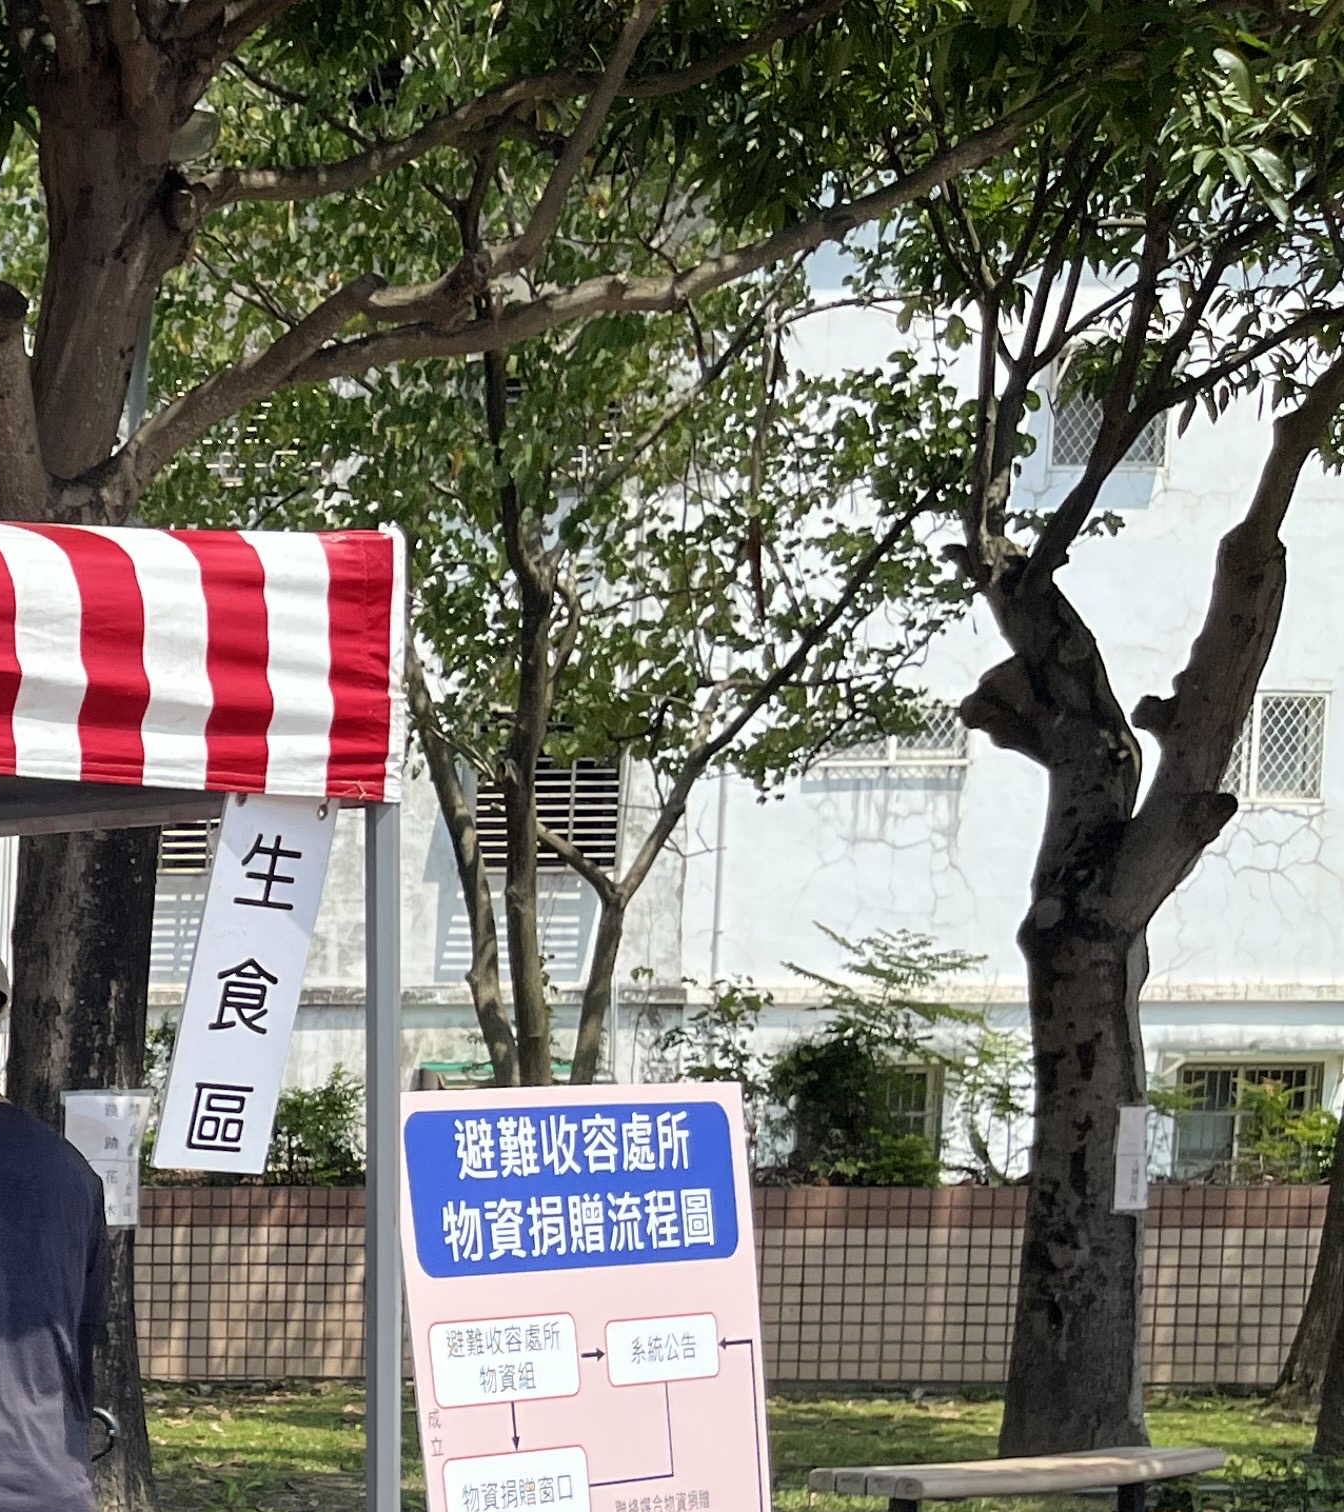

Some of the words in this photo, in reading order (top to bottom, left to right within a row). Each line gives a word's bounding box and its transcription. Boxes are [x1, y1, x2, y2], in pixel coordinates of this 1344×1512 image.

[185, 833, 303, 1152] 生食區
[453, 1111, 690, 1182] 避難收容處所
[442, 1187, 715, 1263] 物資捐贈流程圖
[445, 1321, 561, 1359] 避難收容處所
[629, 1331, 698, 1364] 系統公告
[478, 1362, 537, 1395] 物資組
[428, 1407, 445, 1457] 成立
